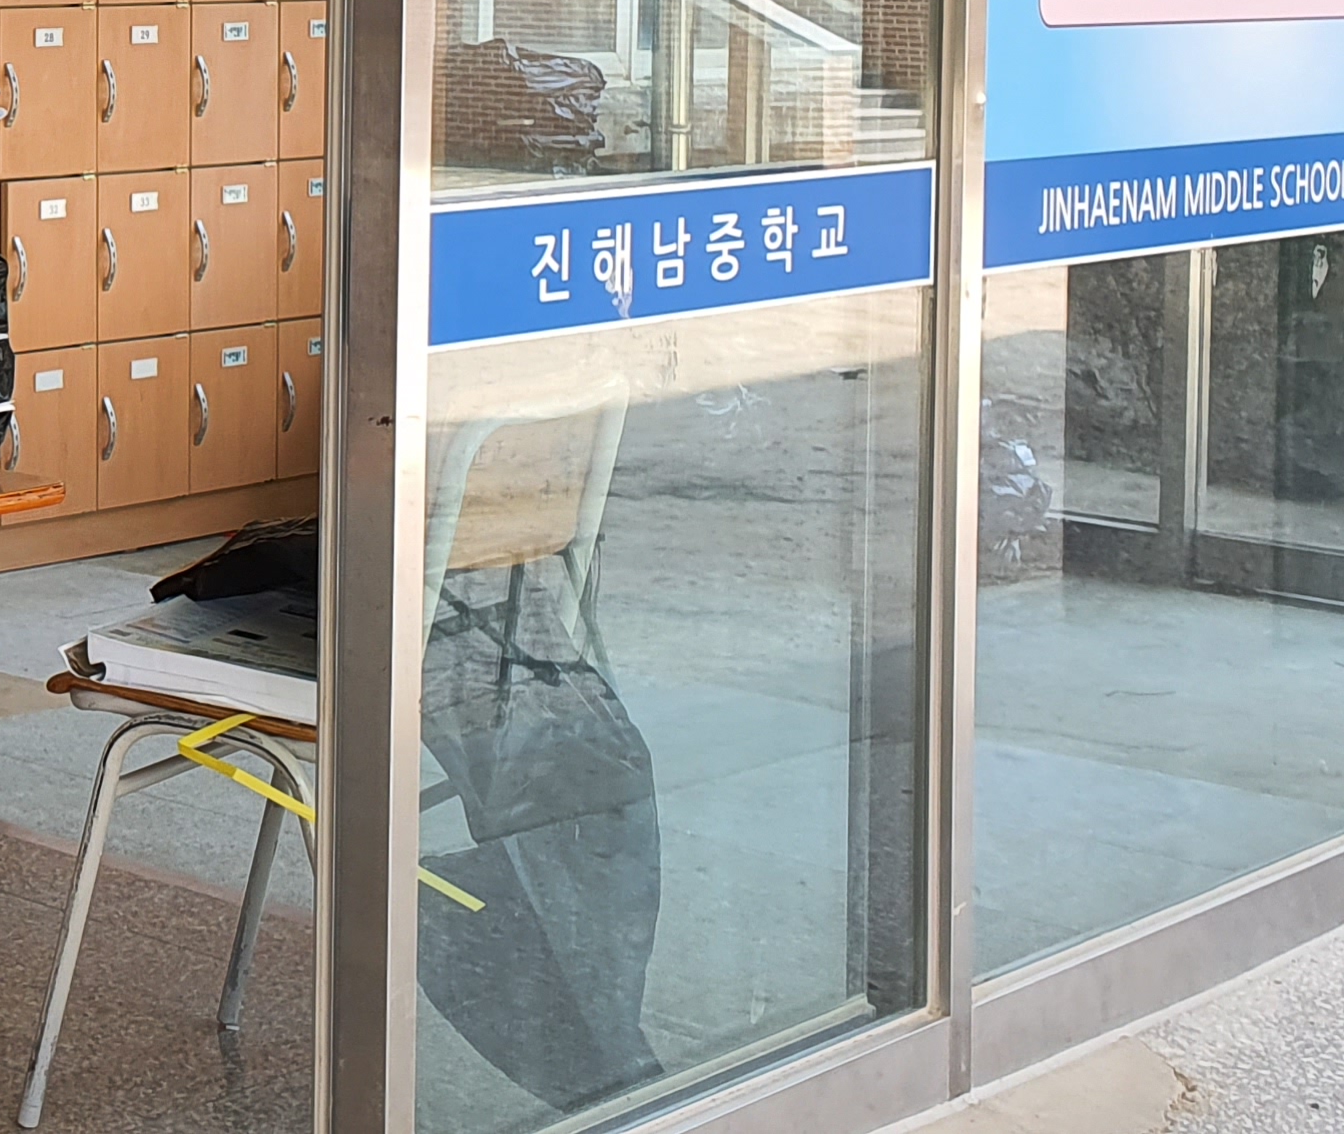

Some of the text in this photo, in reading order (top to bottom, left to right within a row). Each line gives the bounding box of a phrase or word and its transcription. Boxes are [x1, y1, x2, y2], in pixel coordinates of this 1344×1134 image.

[43, 33, 55, 43] 28
[139, 29, 151, 41] 29
[1038, 175, 1178, 234] JINHAENAM
[1184, 168, 1264, 217] MIDDLE
[531, 205, 849, 303] 진해남중학교
